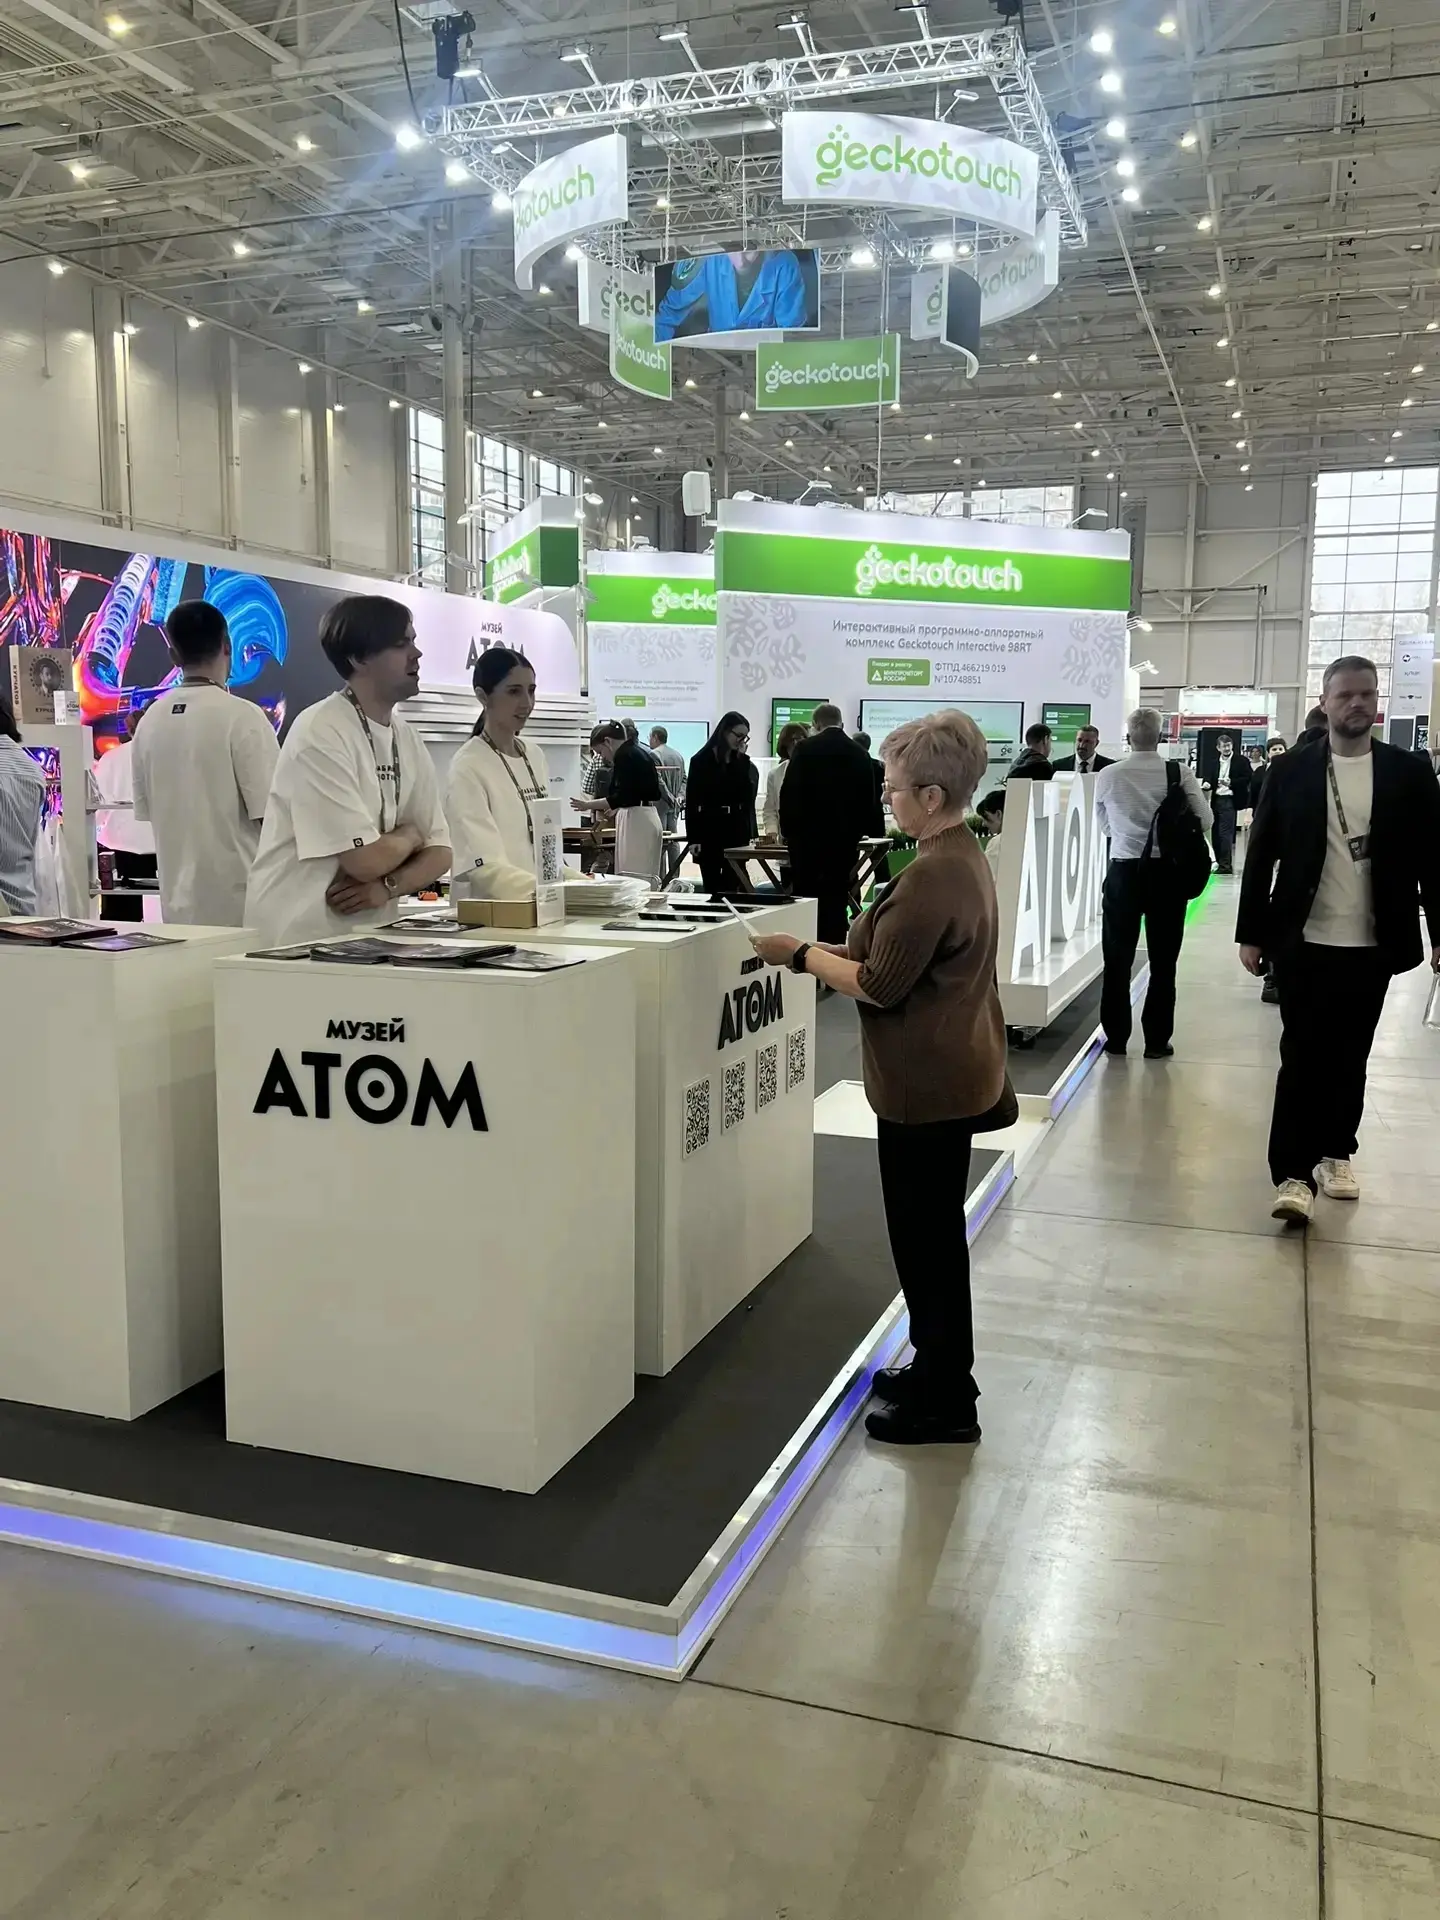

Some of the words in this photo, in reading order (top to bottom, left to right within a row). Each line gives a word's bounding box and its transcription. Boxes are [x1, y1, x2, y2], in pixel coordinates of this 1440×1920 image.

[815, 124, 1022, 199] geckotouch
[764, 360, 890, 393] geckotouch
[855, 544, 1023, 596] geckotouch
[480, 622, 503, 634] МУЗЕЙ
[832, 619, 916, 634] Интерактивный
[918, 625, 1044, 640] программно-аппаратный
[845, 638, 895, 649] комплекс
[898, 638, 954, 650] Geckotouch
[957, 640, 1006, 652] Interactive
[1008, 642, 1032, 652] 98RT
[717, 971, 784, 1050] АТОМ
[326, 1017, 405, 1043] МУЗЕЙ
[253, 1048, 489, 1132] АТОМ
